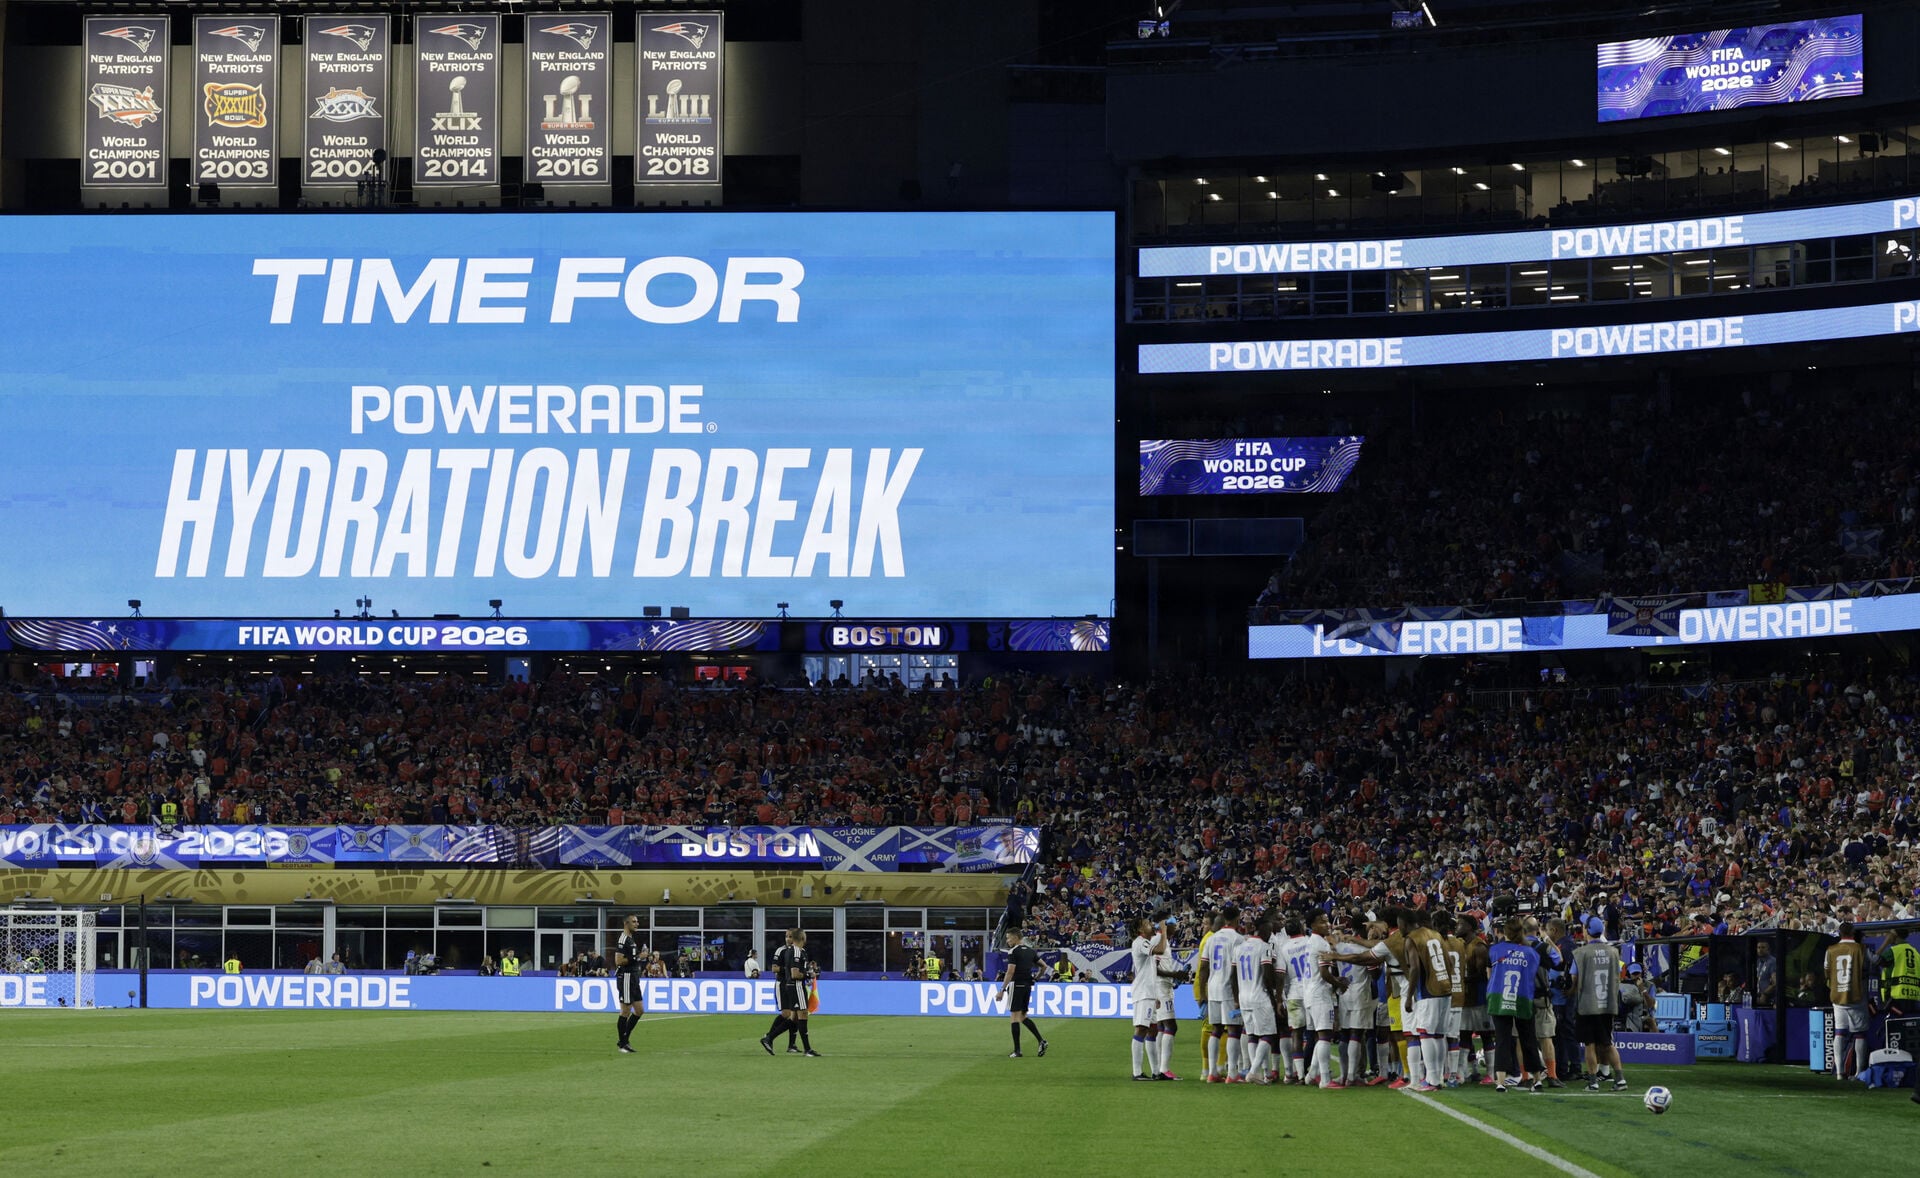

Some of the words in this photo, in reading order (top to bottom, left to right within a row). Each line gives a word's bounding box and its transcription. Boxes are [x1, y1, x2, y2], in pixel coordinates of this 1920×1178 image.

[90, 54, 114, 62] NEW
[116, 54, 162, 63] ENGLAND
[200, 54, 224, 62] NEW
[226, 54, 272, 62] ENGLAND
[310, 53, 334, 61] NEW
[336, 53, 382, 62] ENGLAND
[421, 52, 445, 60] NEW
[447, 52, 493, 61] ENGLAND
[532, 52, 556, 60] NEW
[558, 52, 604, 60] ENGLAND
[643, 51, 667, 59] NEW
[669, 51, 716, 59] ENGLAND
[1712, 47, 1743, 62] FIFA
[99, 64, 153, 74] PATRIOTS
[209, 64, 263, 73] PATRIOTS
[319, 63, 373, 73] PATRIOTS
[430, 62, 484, 71] PATRIOTS
[541, 61, 596, 71] PATRIOTS
[652, 60, 707, 70] PATRIOTS
[1685, 61, 1738, 78] WORLD
[1742, 59, 1771, 73] CUP
[1701, 75, 1753, 92] 2026
[214, 93, 257, 117] XXXVIII
[315, 100, 376, 116] XXXIX
[431, 117, 482, 130] XLIX
[102, 136, 147, 146] WORLD
[212, 136, 256, 146] WORLD
[322, 135, 367, 146] WORLD
[434, 135, 478, 145] WORLD
[545, 134, 590, 145] WORLD
[656, 134, 701, 144] WORLD
[89, 148, 160, 159] CHAMPIONS
[199, 148, 270, 159] CHAMPIONS
[310, 147, 374, 158] CHAMPION
[421, 147, 492, 157] CHAMPIONS
[532, 146, 603, 157] CHAMPIONS
[643, 146, 714, 156] CHAMPIONS
[93, 161, 154, 179] 2001
[200, 161, 268, 178] 2003
[310, 160, 378, 178] 2004
[424, 159, 487, 177] 2014
[536, 159, 599, 177] 2016
[648, 158, 710, 176] 2018
[1210, 240, 1403, 273] POWERADE
[1552, 216, 1744, 258] POWERADE
[252, 258, 535, 324] TIME
[550, 256, 805, 324] FOR
[1210, 338, 1403, 370] POWERADE
[1552, 317, 1744, 357] POWERADE
[1235, 442, 1273, 456] FIFA
[1204, 459, 1267, 473] WORLD
[1270, 458, 1306, 472] CUP
[1222, 475, 1284, 490] 2026
[154, 447, 630, 578] HYDRATION
[633, 448, 923, 578] BREAK
[1314, 618, 1522, 656] PERADE
[1656, 600, 1852, 644] OWERADE
[238, 627, 290, 645] FIFA
[294, 626, 384, 645] WORLD
[388, 626, 437, 645] CUP
[441, 626, 528, 645] 2026
[832, 627, 940, 646] BOSTON
[832, 828, 876, 837] COLOGNE
[1705, 823, 1714, 834] 10
[178, 831, 289, 856] 2026
[682, 833, 820, 857] BOSTON
[977, 862, 997, 871] ARMY
[1214, 945, 1223, 970] 5
[1502, 958, 1528, 967] PHOTO
[1240, 955, 1252, 980] 11
[191, 976, 411, 1008] POWERADE
